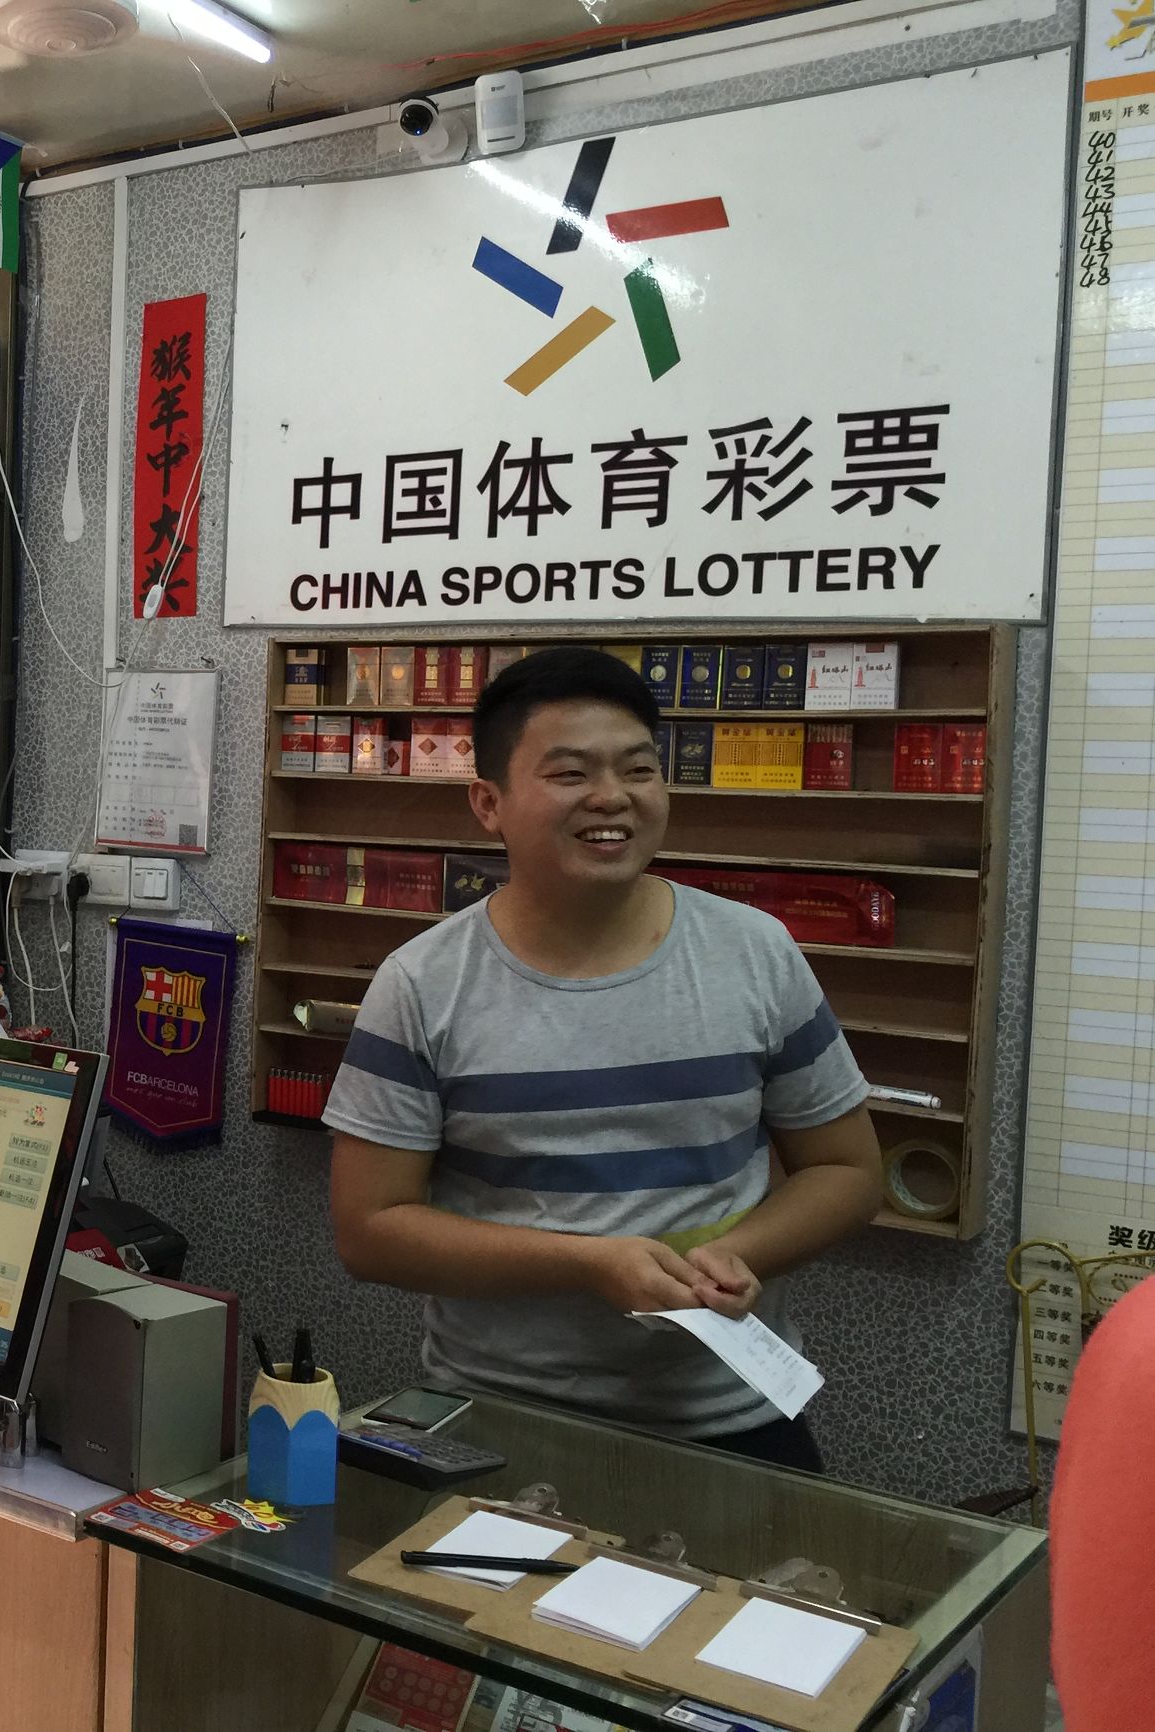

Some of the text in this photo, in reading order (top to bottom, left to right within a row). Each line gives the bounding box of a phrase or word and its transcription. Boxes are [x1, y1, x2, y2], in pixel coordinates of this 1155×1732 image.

[1088, 110, 1113, 123] 期号
[1089, 131, 1116, 149] 40
[1087, 150, 1113, 165] 41
[1085, 166, 1115, 184] 42
[1085, 184, 1115, 202] 43
[1082, 202, 1112, 218] 44
[1084, 217, 1112, 236] 45
[1081, 252, 1109, 270] 47
[1080, 268, 1110, 287] 48
[290, 404, 950, 548] 中国体育彩票
[289, 544, 941, 611] CHINA SPORTS LOTTERY
[156, 1002, 184, 1018] FCB
[1109, 1225, 1155, 1251] 奖级
[1037, 1259, 1074, 1273] 一等奖
[1035, 1306, 1072, 1323] 三等奖
[1033, 1329, 1071, 1346] 四等奖
[1032, 1353, 1069, 1370] 五等奖
[1032, 1377, 1068, 1396] 六等奖
